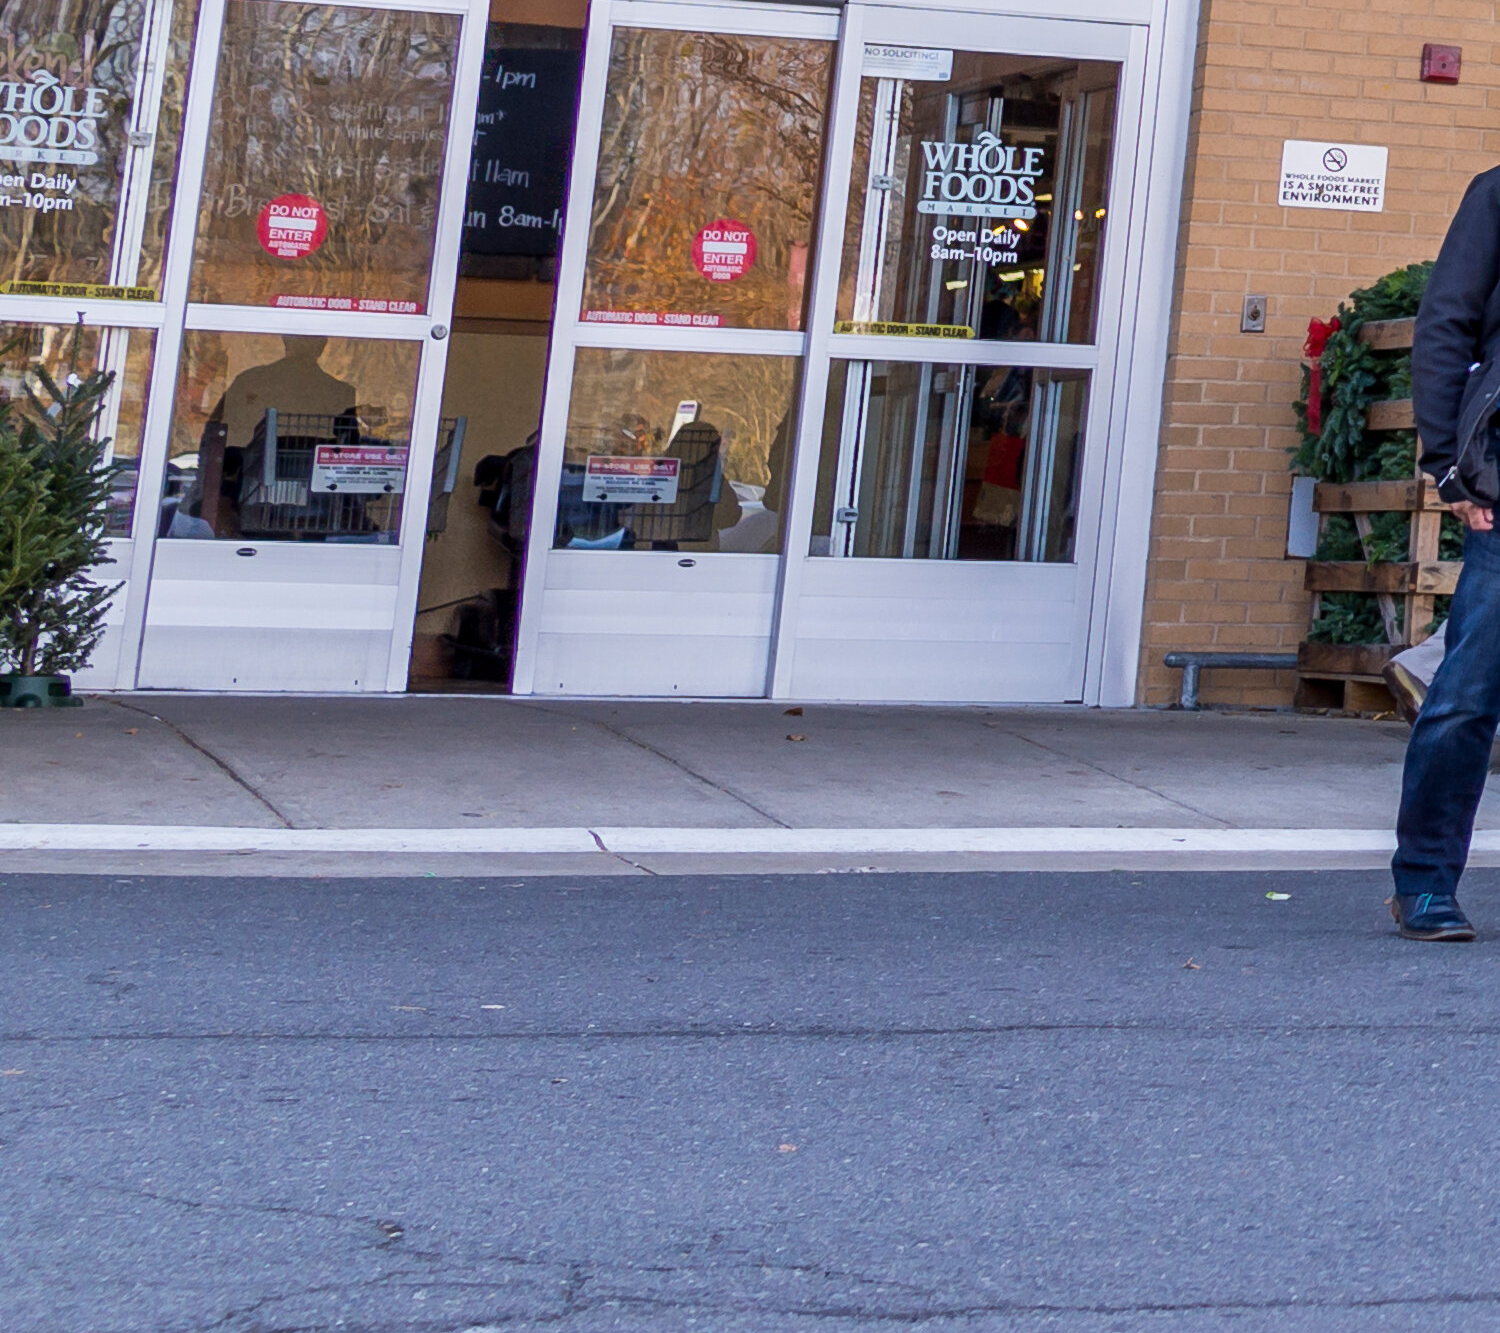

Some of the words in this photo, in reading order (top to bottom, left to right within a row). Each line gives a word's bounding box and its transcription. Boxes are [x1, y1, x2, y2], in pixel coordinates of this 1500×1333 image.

[864, 47, 880, 56] NO
[0, 69, 109, 118] HOLE
[921, 131, 1044, 177] WHOLE
[30, 172, 77, 194] Daily
[1283, 180, 1294, 189] IS
[1297, 181, 1304, 190] A
[1285, 172, 1315, 181] WHOLE
[1317, 174, 1344, 182] FOODS
[1347, 176, 1380, 184] MARKET
[923, 171, 1035, 205] FOODS
[1282, 190, 1379, 206] ENVIRONMENT
[270, 204, 289, 216] DO
[292, 206, 319, 218] NOT
[926, 203, 1028, 217] MARKET
[269, 229, 312, 242] ENTER
[703, 229, 721, 241] DO
[723, 231, 749, 242] NOT
[933, 226, 976, 244] Open
[980, 226, 1020, 248] Daily
[703, 253, 744, 265] ENTER
